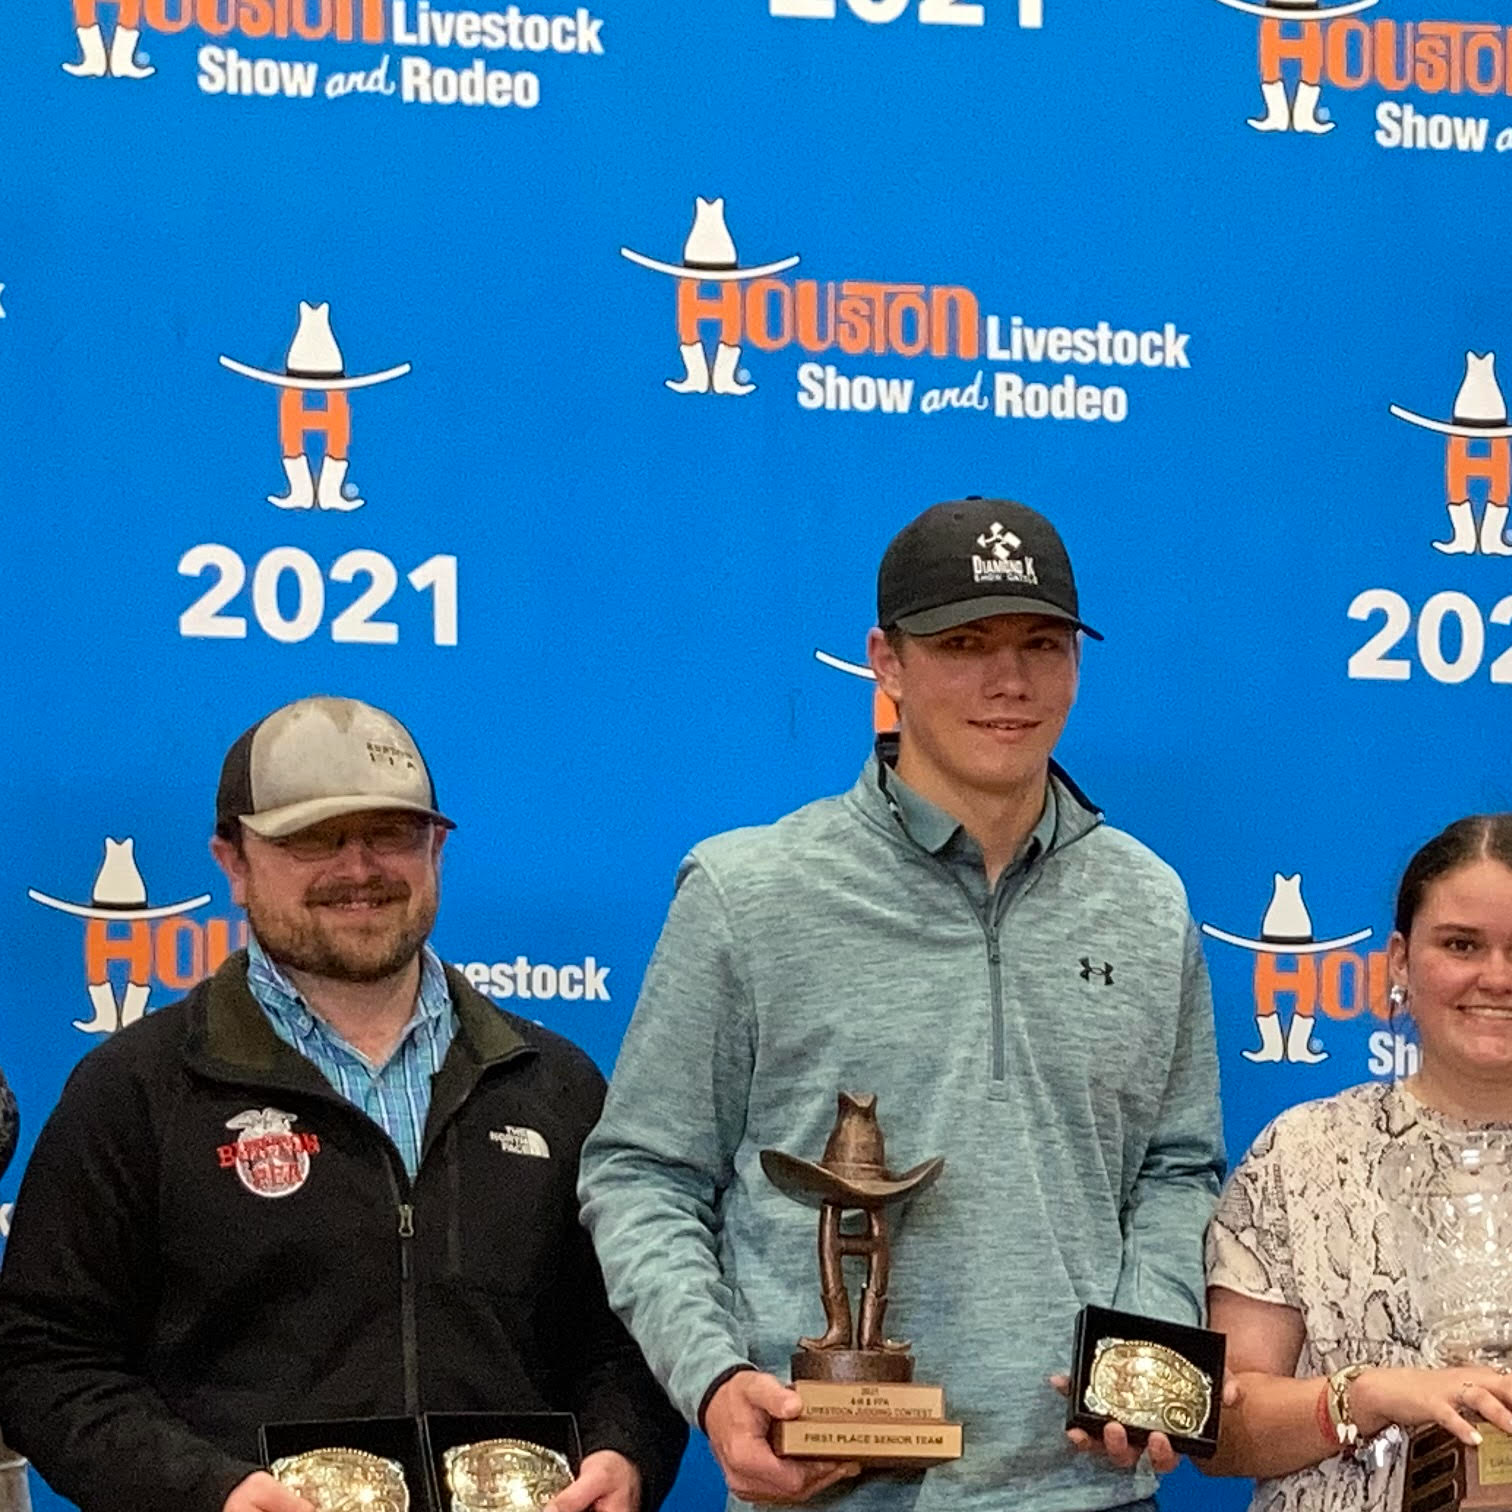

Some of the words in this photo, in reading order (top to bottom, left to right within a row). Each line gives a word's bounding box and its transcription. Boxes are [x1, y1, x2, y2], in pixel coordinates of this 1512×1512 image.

[392, 1, 604, 54] Livestock
[197, 46, 318, 97] Show
[324, 53, 396, 98] and
[401, 56, 540, 108] Rodeo
[1375, 101, 1489, 152] Show
[986, 315, 1190, 368] Livestock
[797, 362, 914, 413] Show
[920, 370, 989, 414] and
[994, 372, 1128, 422] Rodeo
[177, 543, 458, 646] 2021
[454, 955, 612, 1001] estock
[1368, 1031, 1422, 1076] Sh
